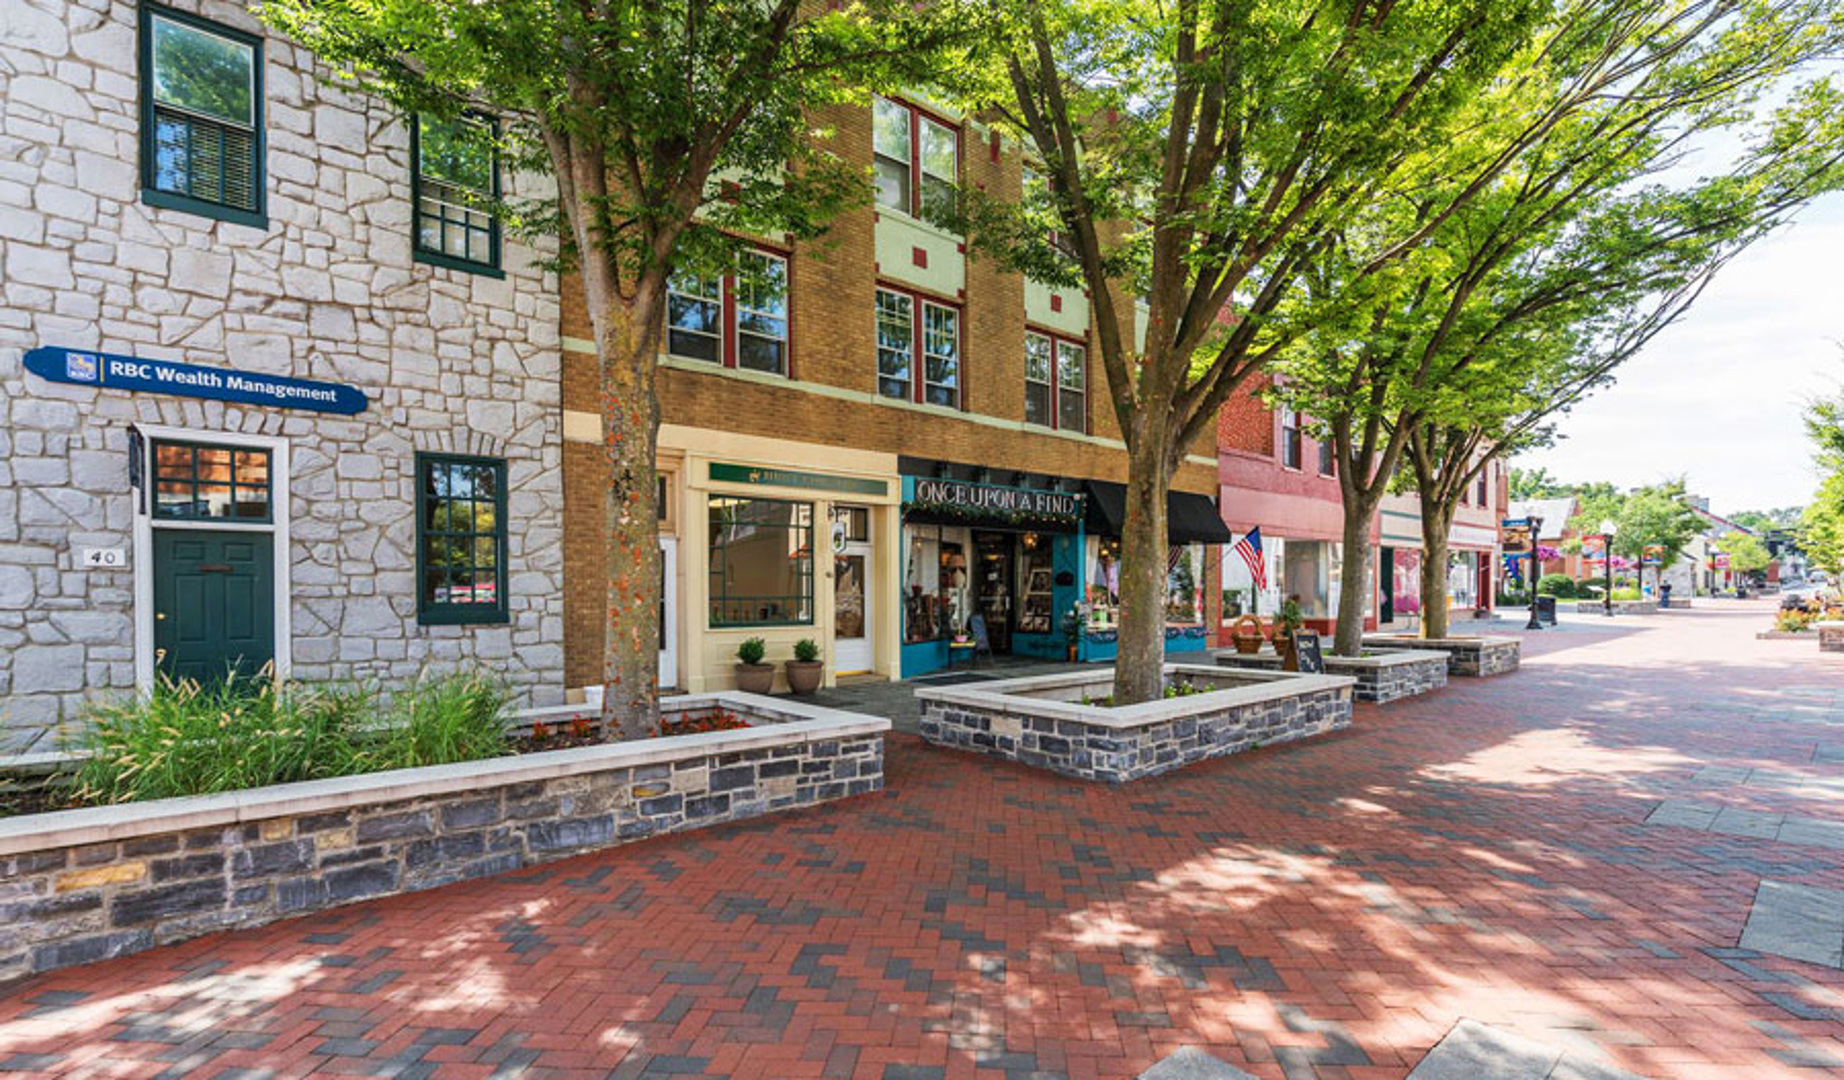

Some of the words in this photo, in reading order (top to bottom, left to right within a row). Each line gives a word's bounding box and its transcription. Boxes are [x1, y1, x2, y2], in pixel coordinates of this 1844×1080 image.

[110, 360, 152, 379] RBC
[155, 366, 222, 387] Wealth
[227, 376, 337, 402] Management
[917, 481, 967, 505] ONCE
[970, 486, 1016, 510] UPON
[1019, 493, 1032, 511] A
[1036, 494, 1075, 513] FIND
[91, 551, 115, 564] 40
